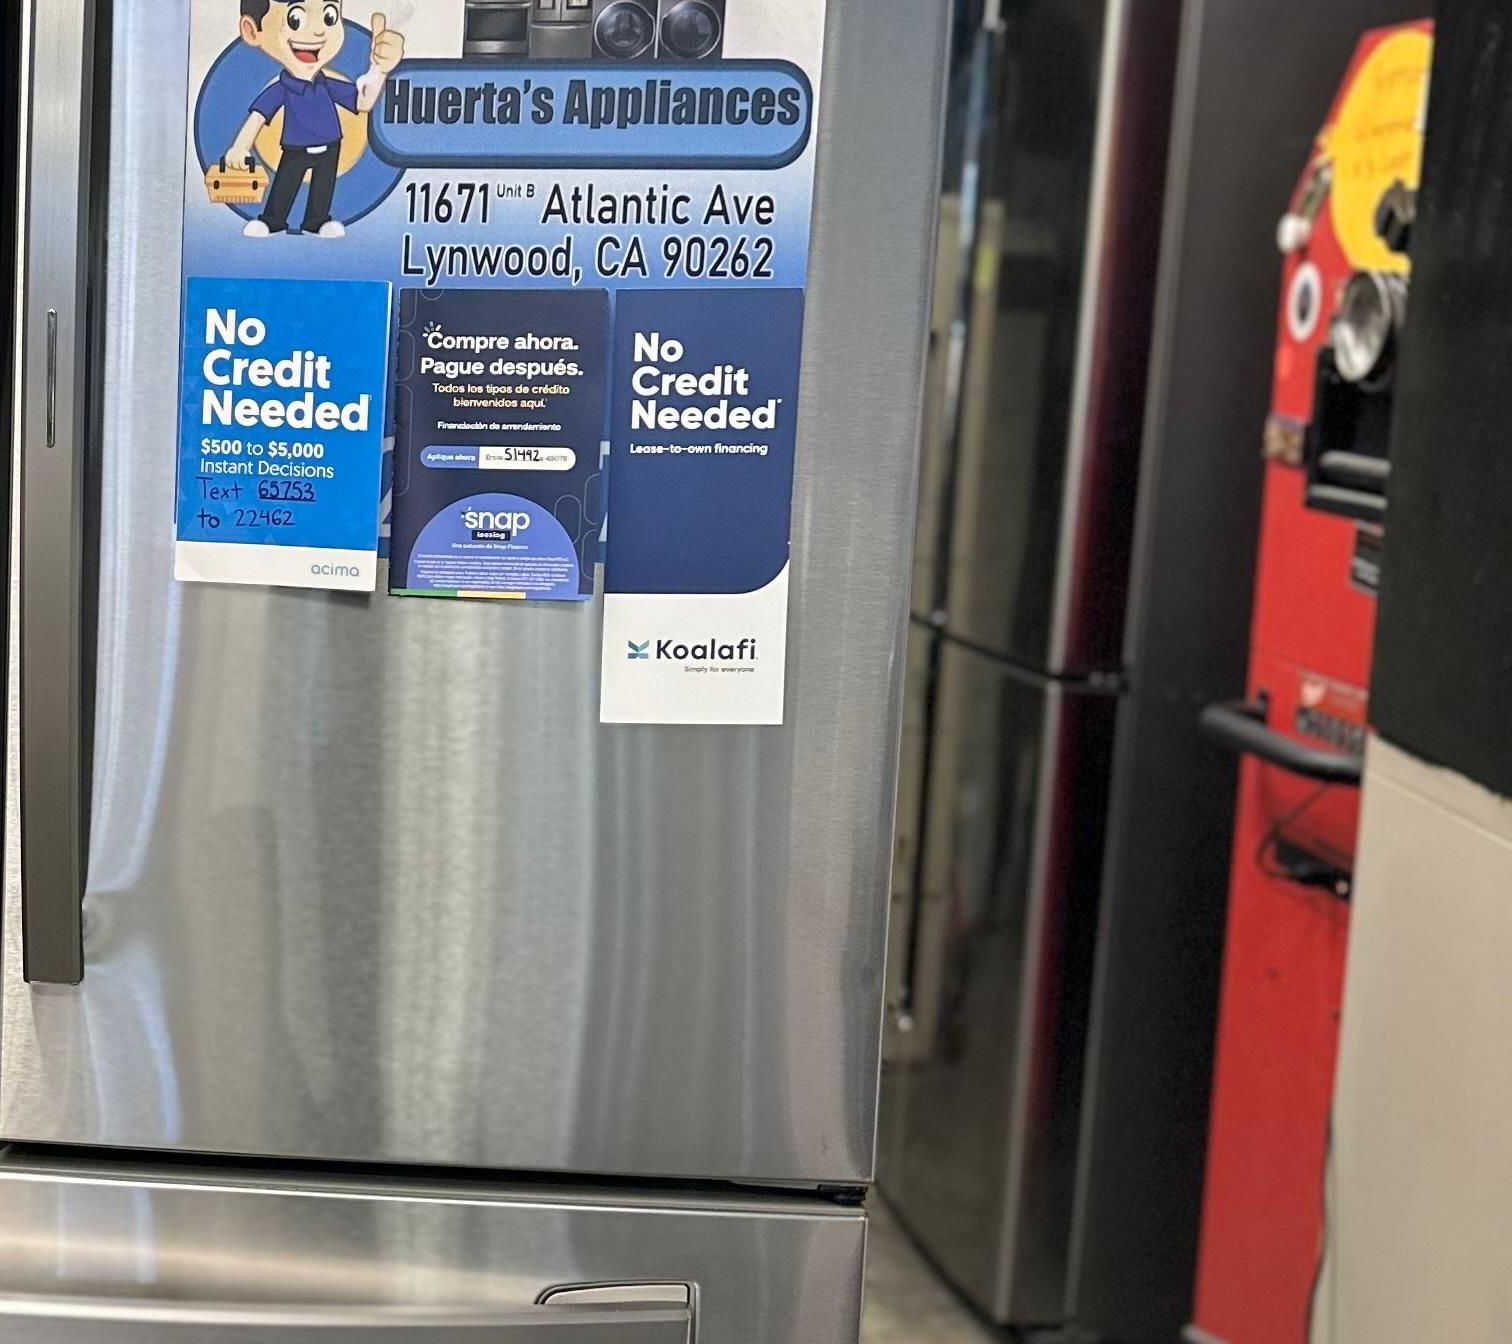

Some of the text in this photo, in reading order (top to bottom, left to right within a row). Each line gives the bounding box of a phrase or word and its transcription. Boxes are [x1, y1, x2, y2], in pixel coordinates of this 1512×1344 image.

[384, 78, 800, 130] Huerta's Appliances
[405, 181, 775, 226] 11671 Unit B Atlantic Ave
[402, 235, 774, 286] Lynwood, CA 90262
[205, 308, 266, 346] No
[427, 331, 579, 354] Compre ahora.
[633, 332, 684, 363] No
[203, 348, 332, 390] Credit
[420, 357, 584, 380] Pague después.
[432, 382, 571, 398] Todos los tipos de crédito
[632, 364, 749, 397] Credit
[453, 396, 518, 408] bienvenidos
[200, 437, 325, 460] $500 to $5,000
[504, 447, 541, 462] 51492
[630, 442, 769, 456] Lease-to-own financing
[200, 458, 335, 479] Instant Decisions
[195, 476, 317, 502] Text 65753
[197, 508, 297, 529] to 22462
[463, 510, 531, 537] snap
[310, 562, 361, 578] acima
[655, 638, 756, 660] Koalafi
